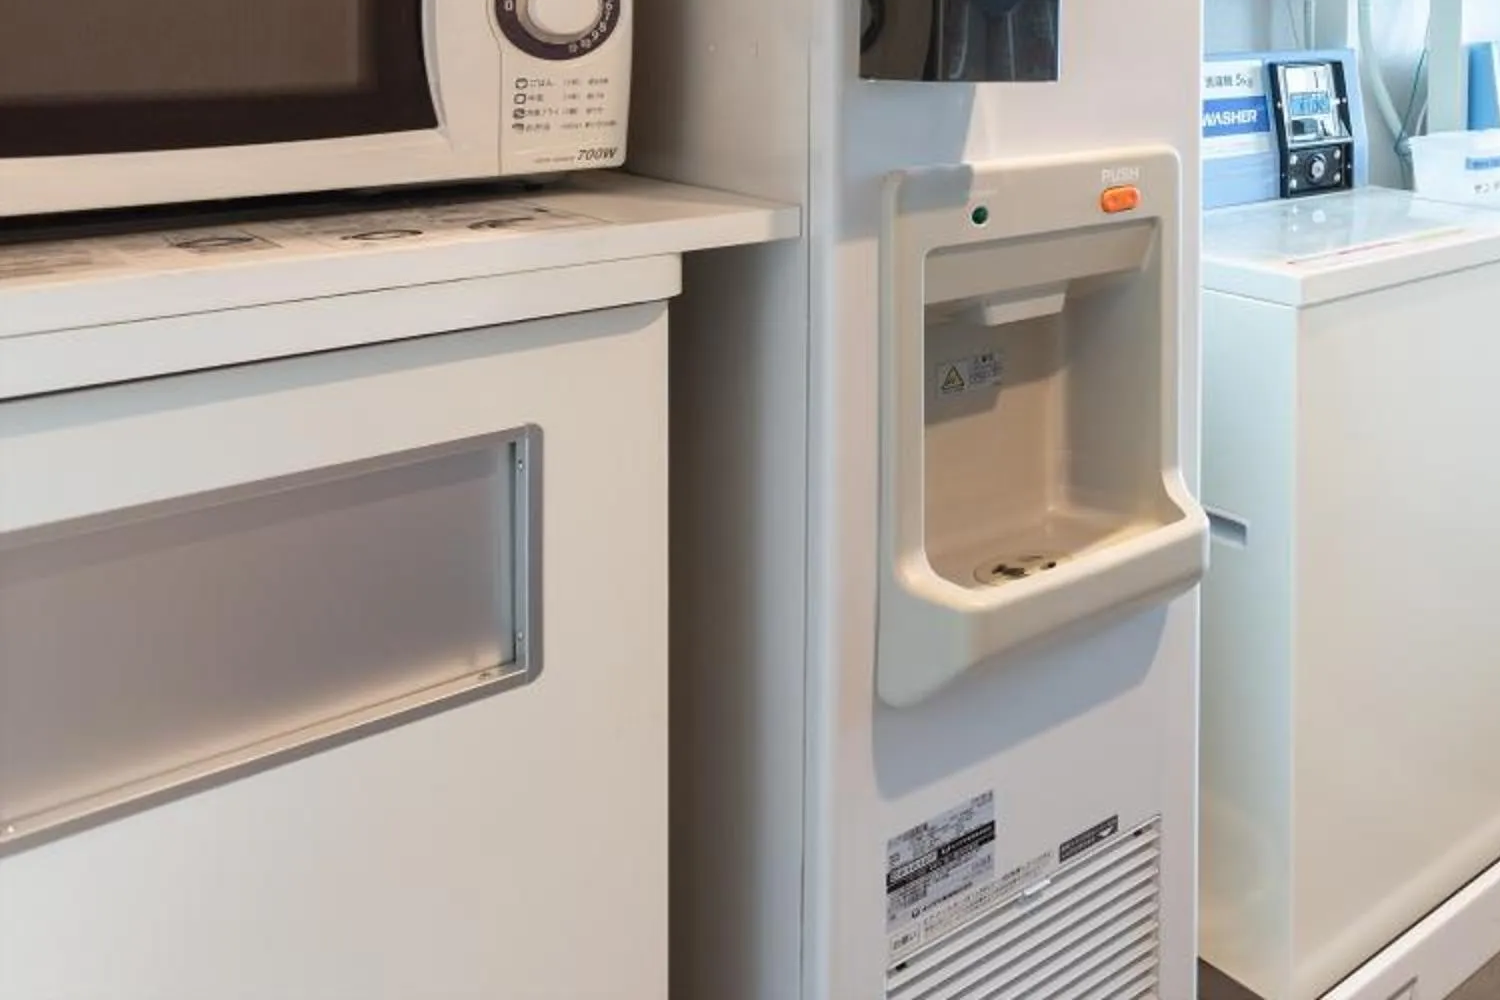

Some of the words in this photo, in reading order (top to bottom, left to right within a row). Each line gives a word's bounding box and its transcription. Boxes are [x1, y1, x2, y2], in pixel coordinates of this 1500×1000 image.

[1200, 108, 1257, 128] WASHER
[577, 147, 618, 161] 700W
[1101, 166, 1140, 184] PUSH
